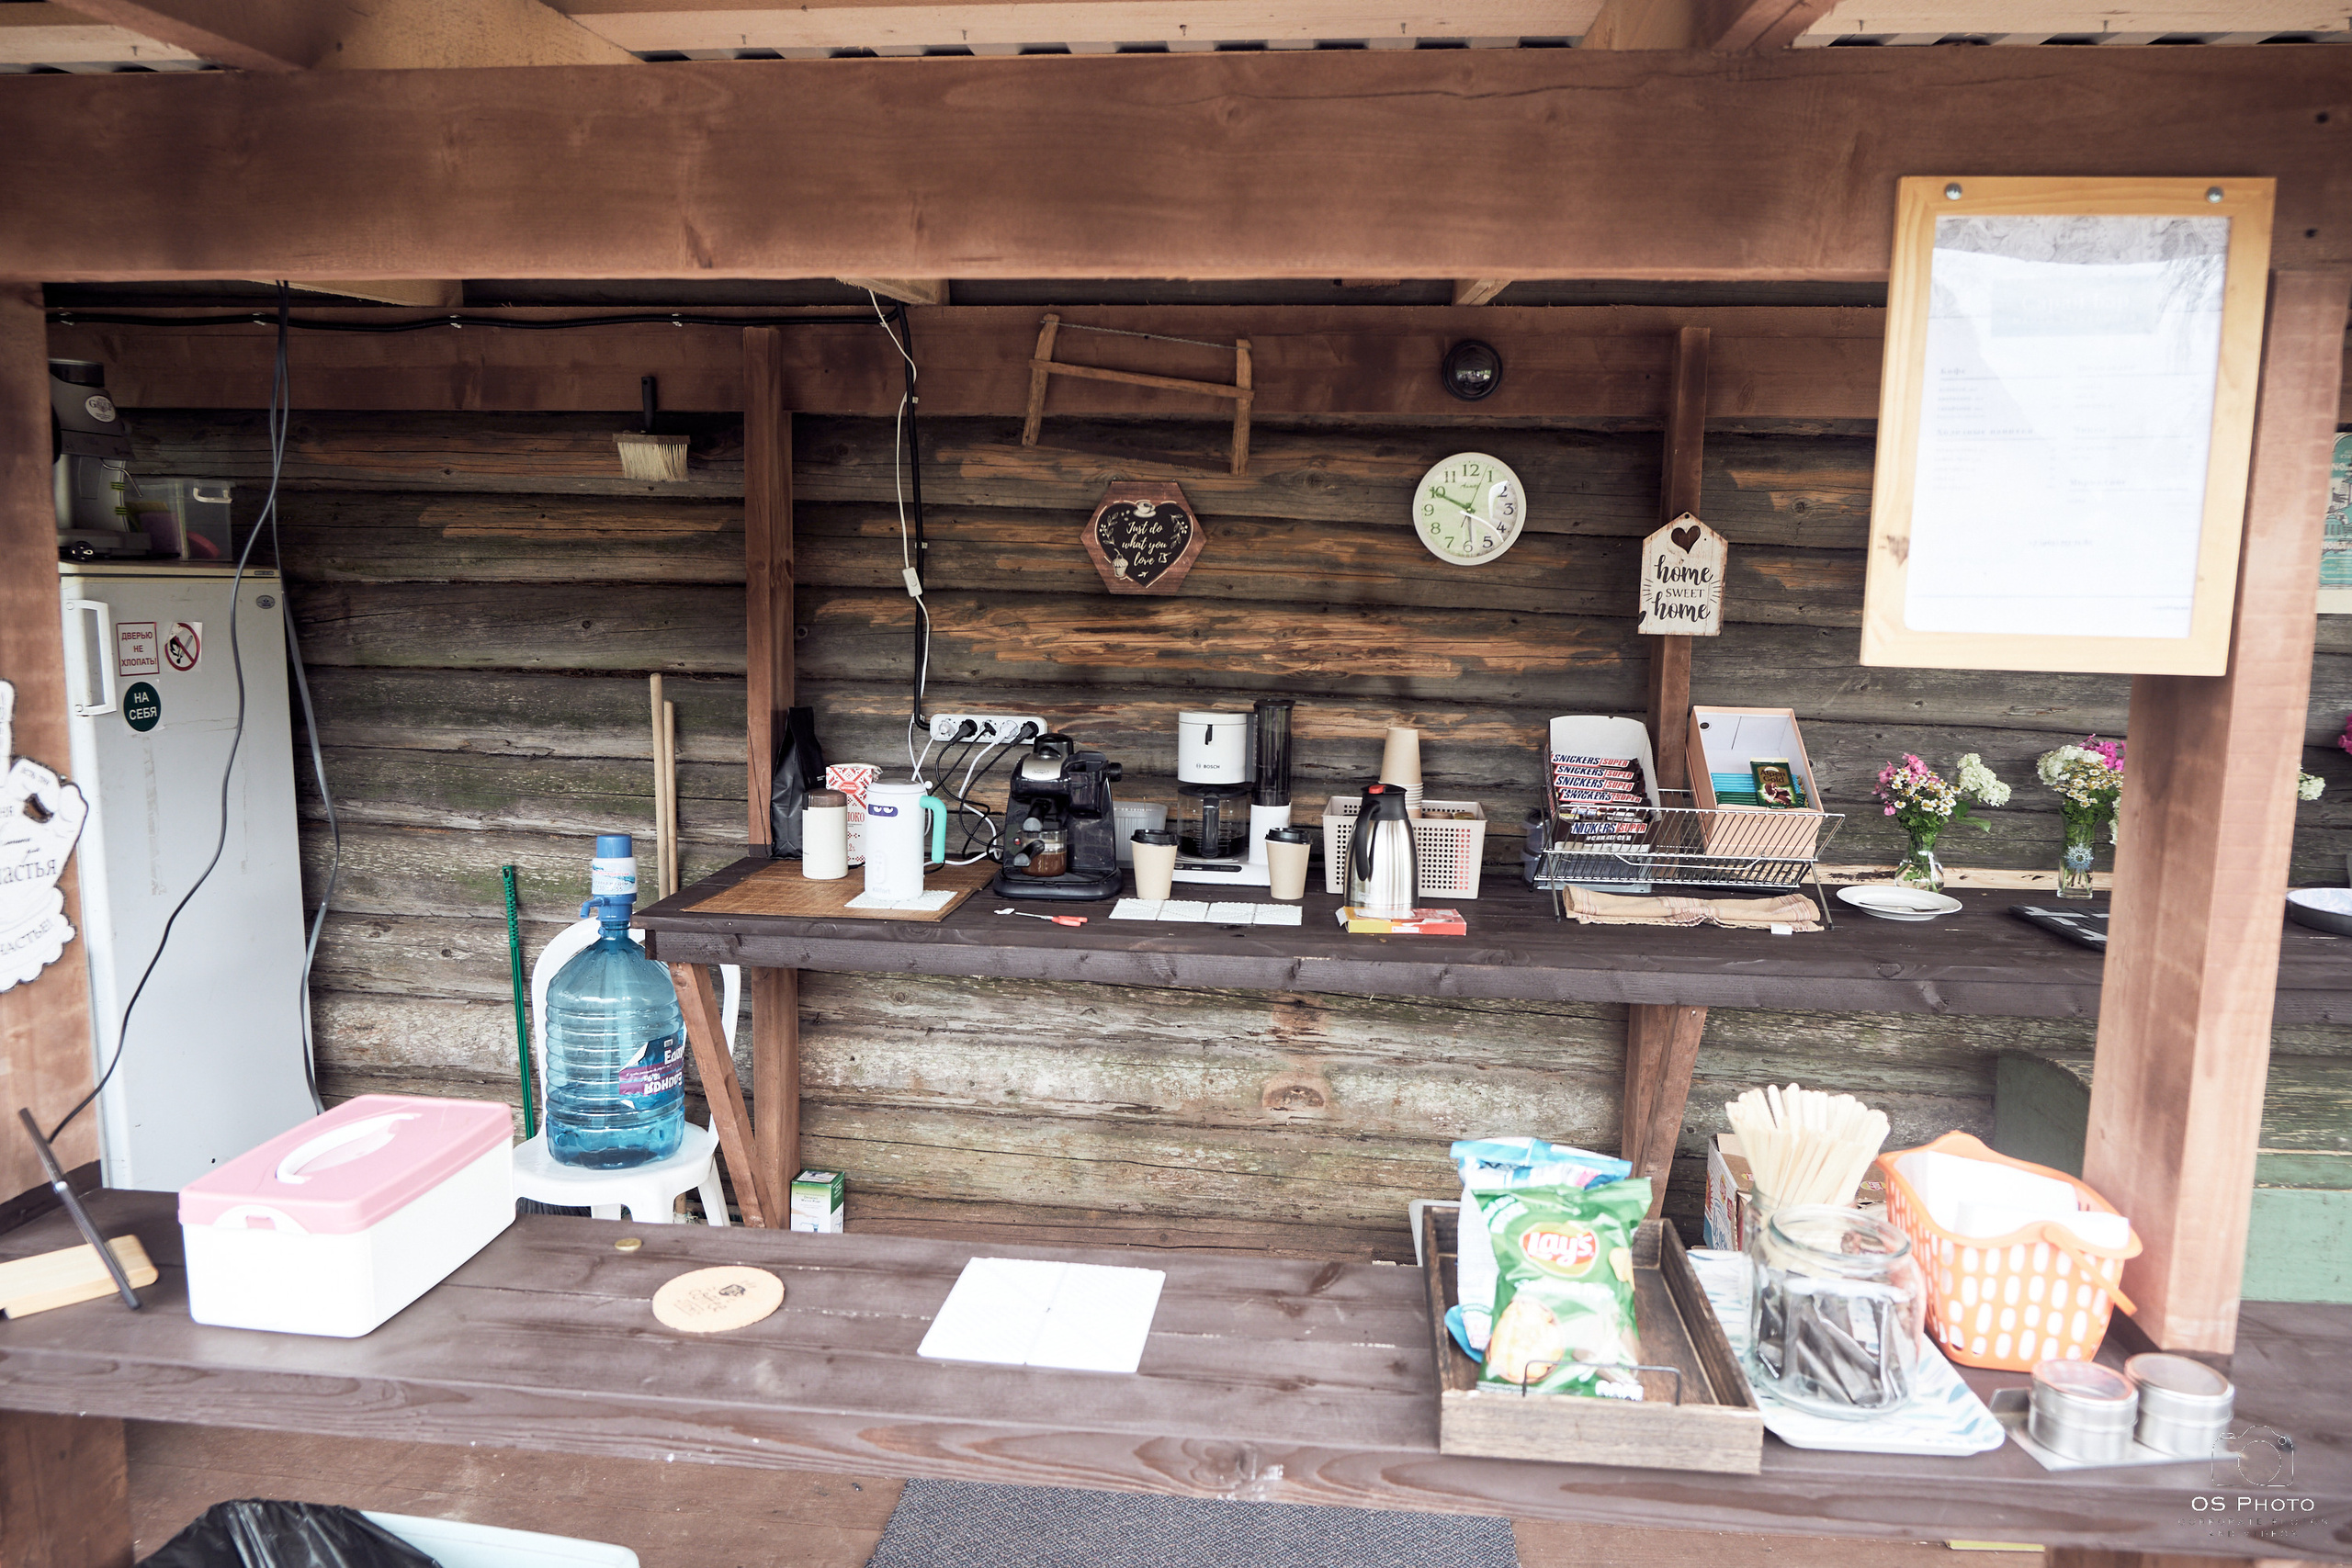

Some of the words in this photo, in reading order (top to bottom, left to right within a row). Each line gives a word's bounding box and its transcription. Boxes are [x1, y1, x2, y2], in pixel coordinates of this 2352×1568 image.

[1444, 470, 1456, 483] 11
[1463, 464, 1479, 477] 12
[1487, 470, 1493, 482] 1
[1430, 486, 1446, 499] 10
[1424, 503, 1434, 516] 9
[1503, 502, 1514, 515] 3
[1126, 521, 1148, 535] Just
[1149, 523, 1163, 533] do
[1430, 522, 1442, 535] 8
[1496, 522, 1507, 533] 4
[1122, 534, 1148, 550] what
[1148, 541, 1168, 555] you
[1444, 536, 1454, 548] 7
[1463, 540, 1474, 553] 6
[1483, 536, 1494, 548] 5
[1134, 552, 1155, 567] love
[1654, 554, 1714, 586] home
[1666, 588, 1705, 599] SWEET
[1651, 591, 1711, 623] home
[121, 631, 153, 641] ДВЕРЬЮ
[133, 645, 144, 653] НЕ
[121, 658, 157, 667] ХЛОПАТЬ!
[133, 692, 150, 704] НА
[129, 706, 157, 720] СЕБЯ
[1553, 754, 1600, 765] SNICKERS
[1602, 760, 1629, 768] SUPER
[1557, 765, 1605, 777] SNICKERS
[1607, 770, 1634, 779] SUPER
[1760, 770, 1786, 778] Alpen
[1555, 776, 1605, 789] SNICKERS
[1606, 782, 1634, 791] SUPER
[1763, 775, 1785, 784] Gold
[1564, 792, 1611, 801] SNICKERS
[1527, 1229, 1595, 1267] Lay's
